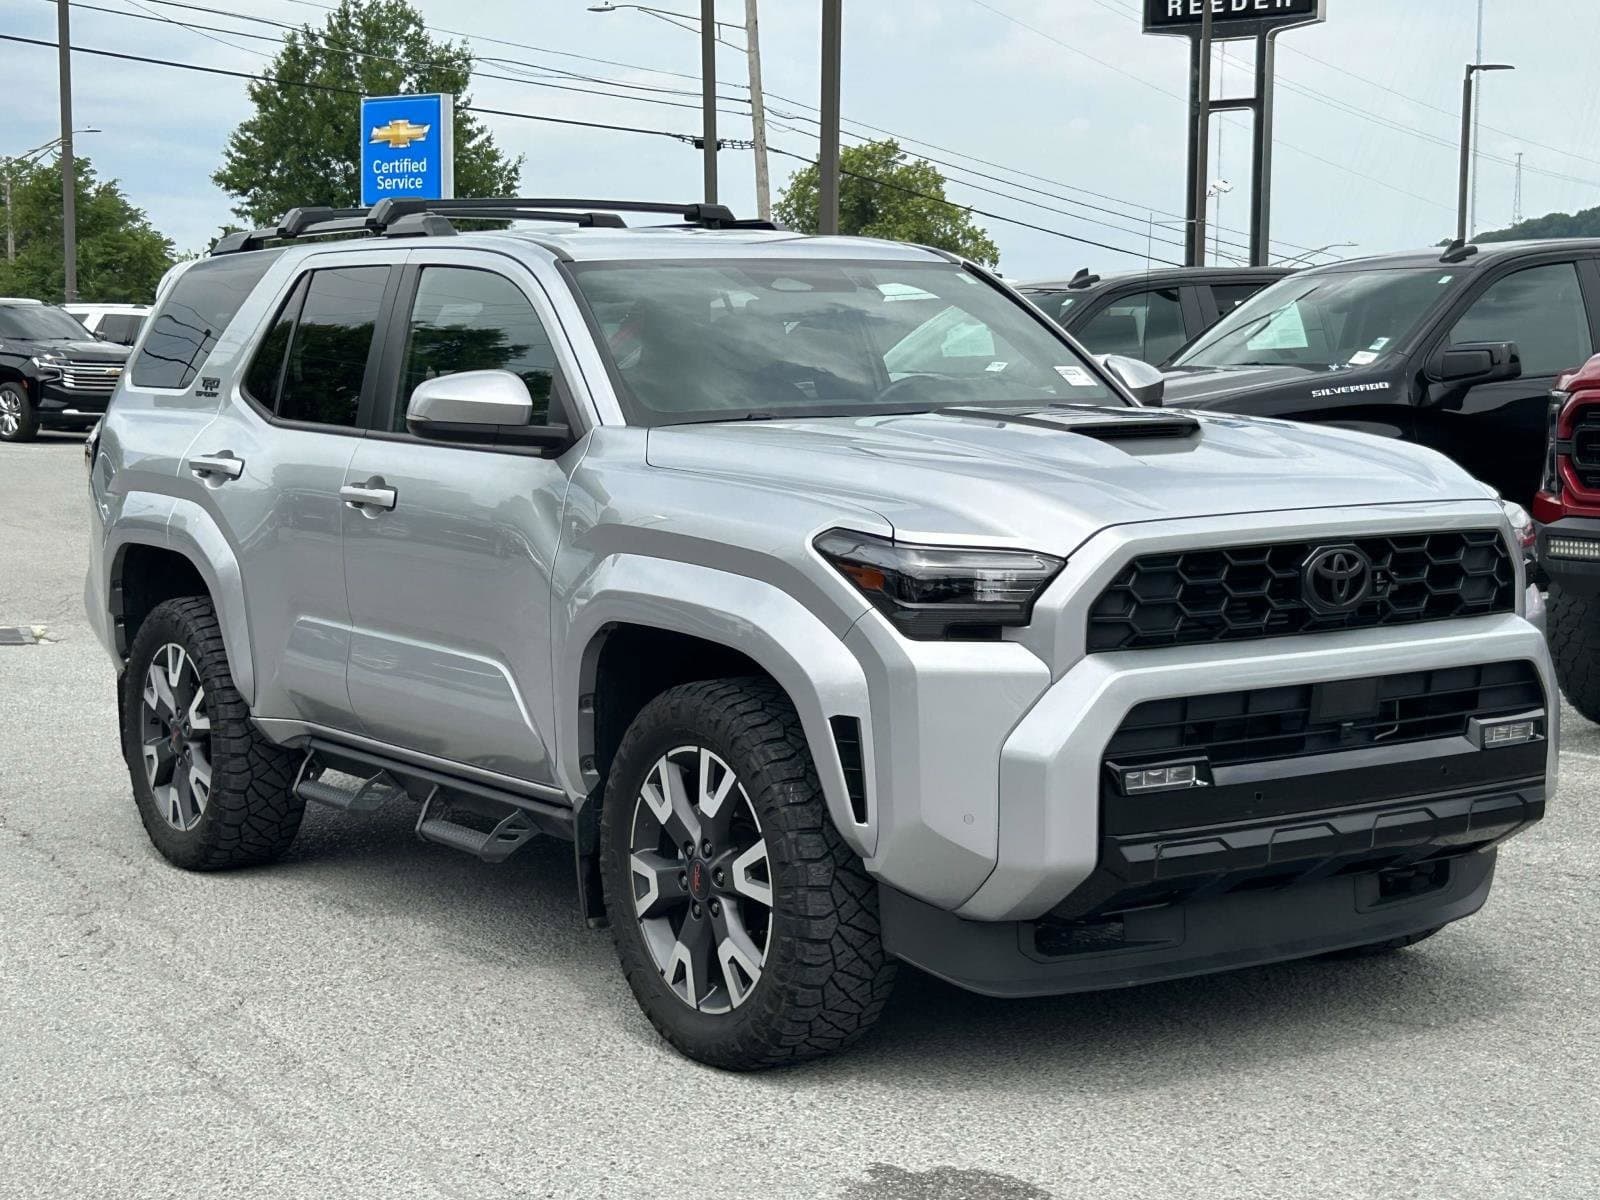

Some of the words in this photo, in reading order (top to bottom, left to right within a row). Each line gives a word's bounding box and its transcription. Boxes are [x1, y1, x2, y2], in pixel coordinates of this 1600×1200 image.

[373, 157, 426, 173] Certified
[376, 174, 423, 190] Service
[1311, 381, 1390, 398] SILVERADO
